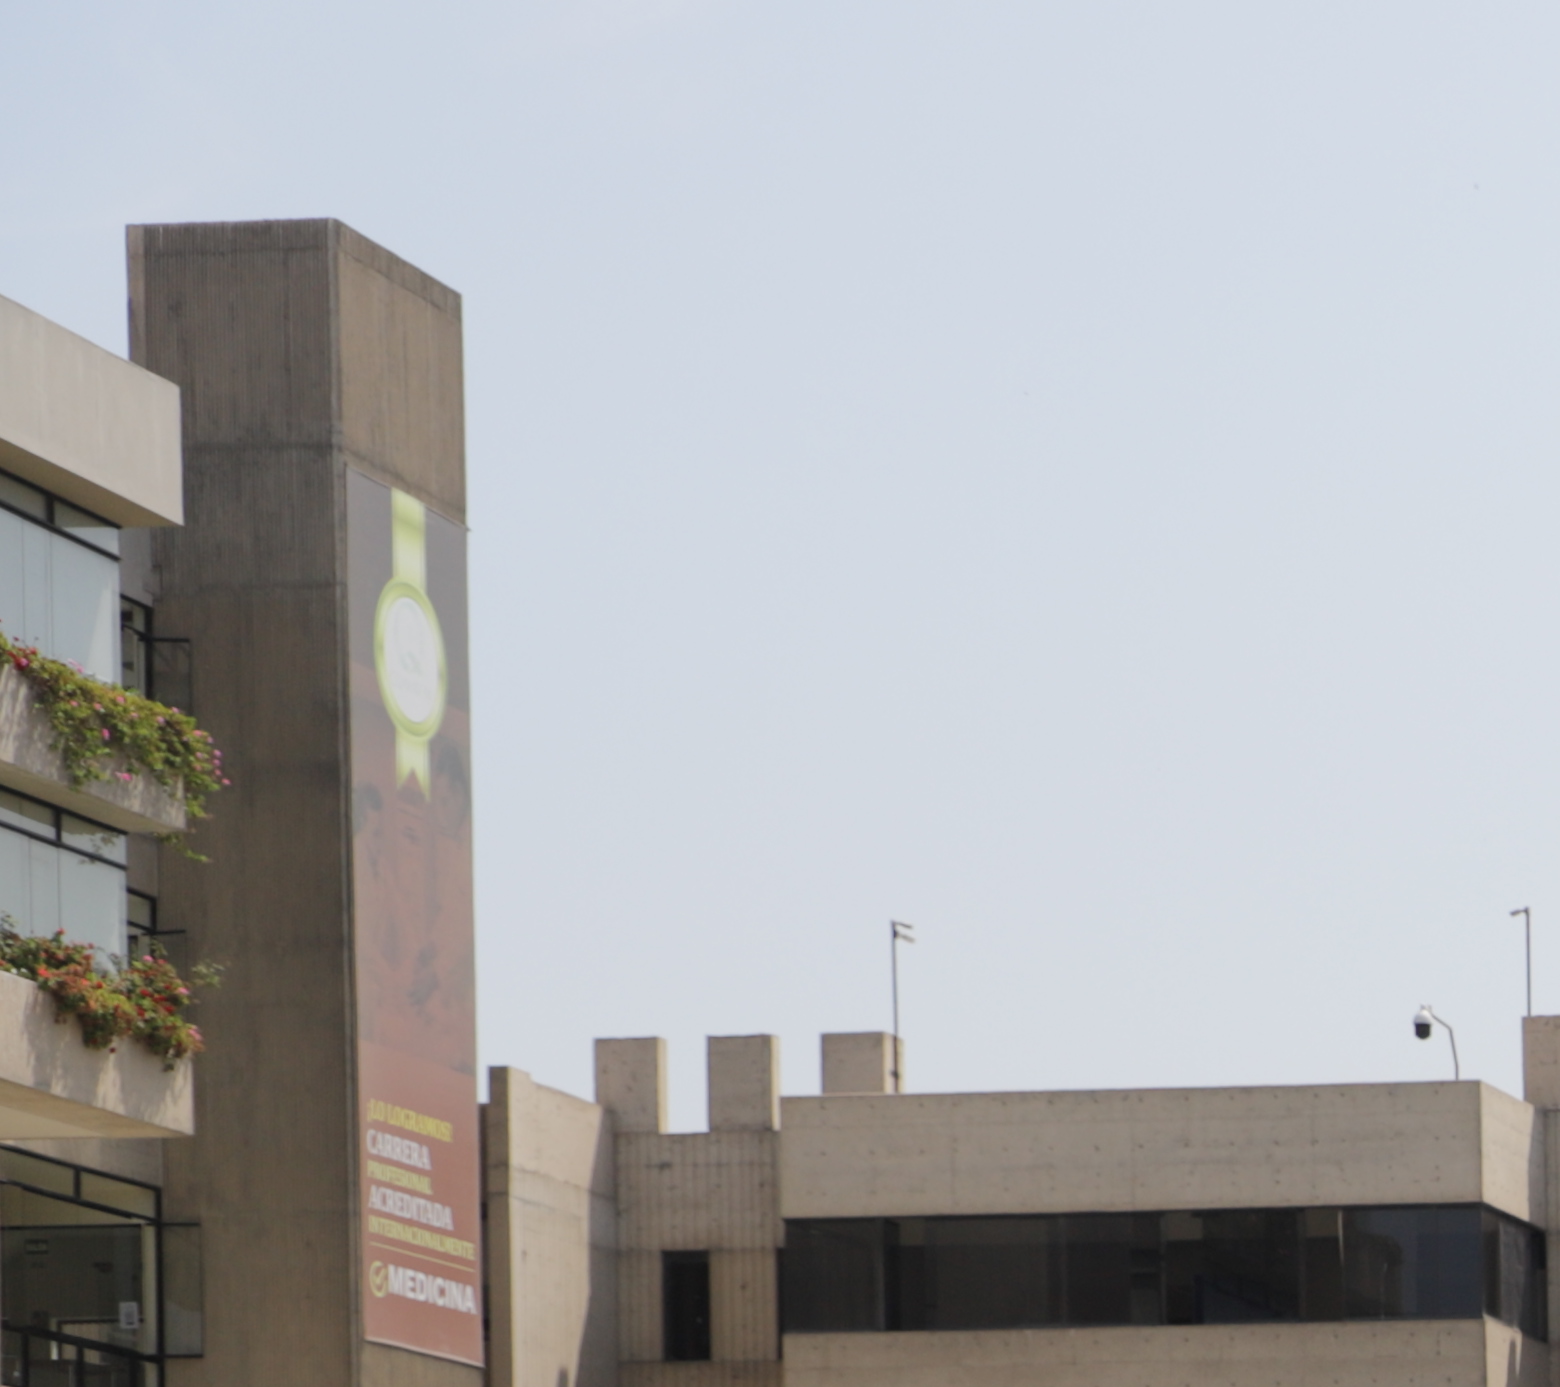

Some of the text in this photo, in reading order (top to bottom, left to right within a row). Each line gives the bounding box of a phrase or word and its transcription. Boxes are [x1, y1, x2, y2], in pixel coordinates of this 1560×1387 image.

[366, 1128, 432, 1171] CARRERA
[368, 1184, 454, 1231] ACREDITADA
[387, 1263, 478, 1315] MEDICINA
